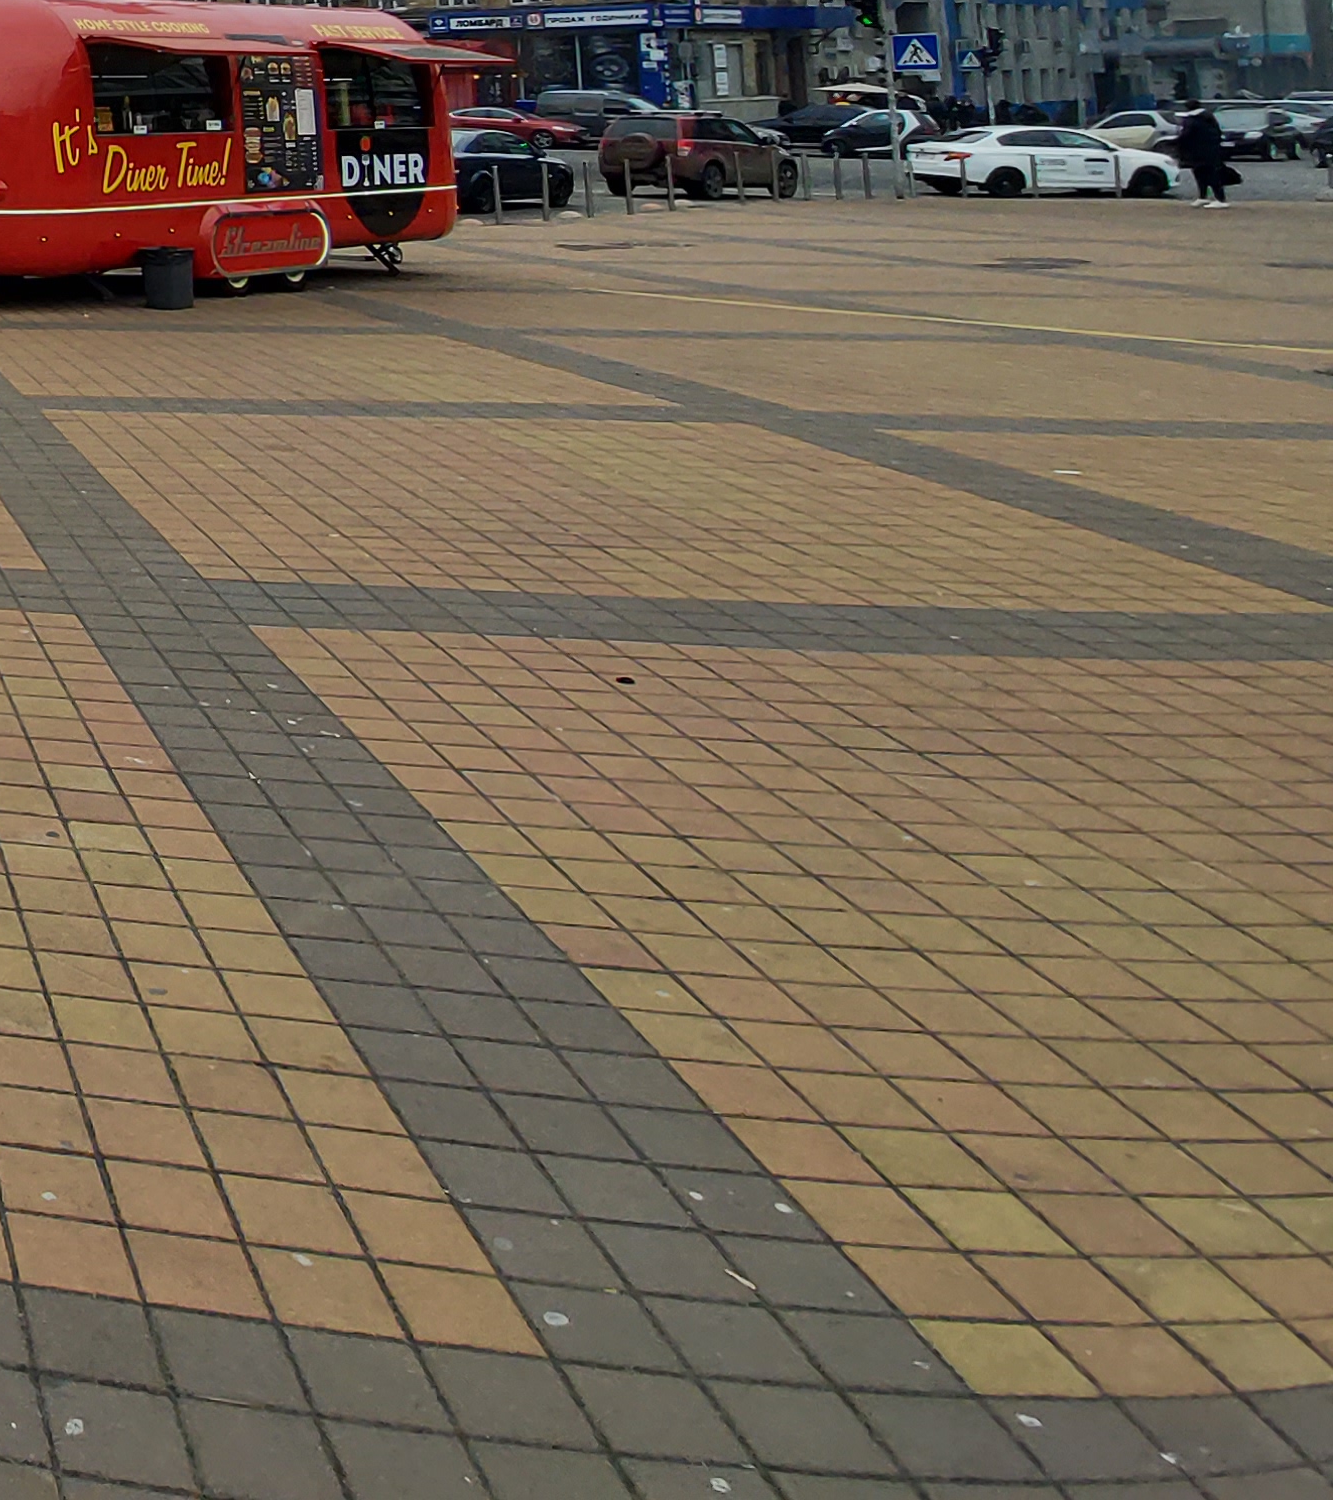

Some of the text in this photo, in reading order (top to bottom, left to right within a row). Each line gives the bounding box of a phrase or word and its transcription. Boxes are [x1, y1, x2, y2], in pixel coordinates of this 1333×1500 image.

[73, 19, 210, 34] HOME STYLE COOKING
[455, 18, 504, 28] ЛОМБАРД
[311, 24, 406, 40] FAST SERVICE
[52, 107, 99, 174] It's
[102, 144, 169, 194] Diner
[176, 137, 232, 188] Time!
[219, 222, 322, 257] Streamline
